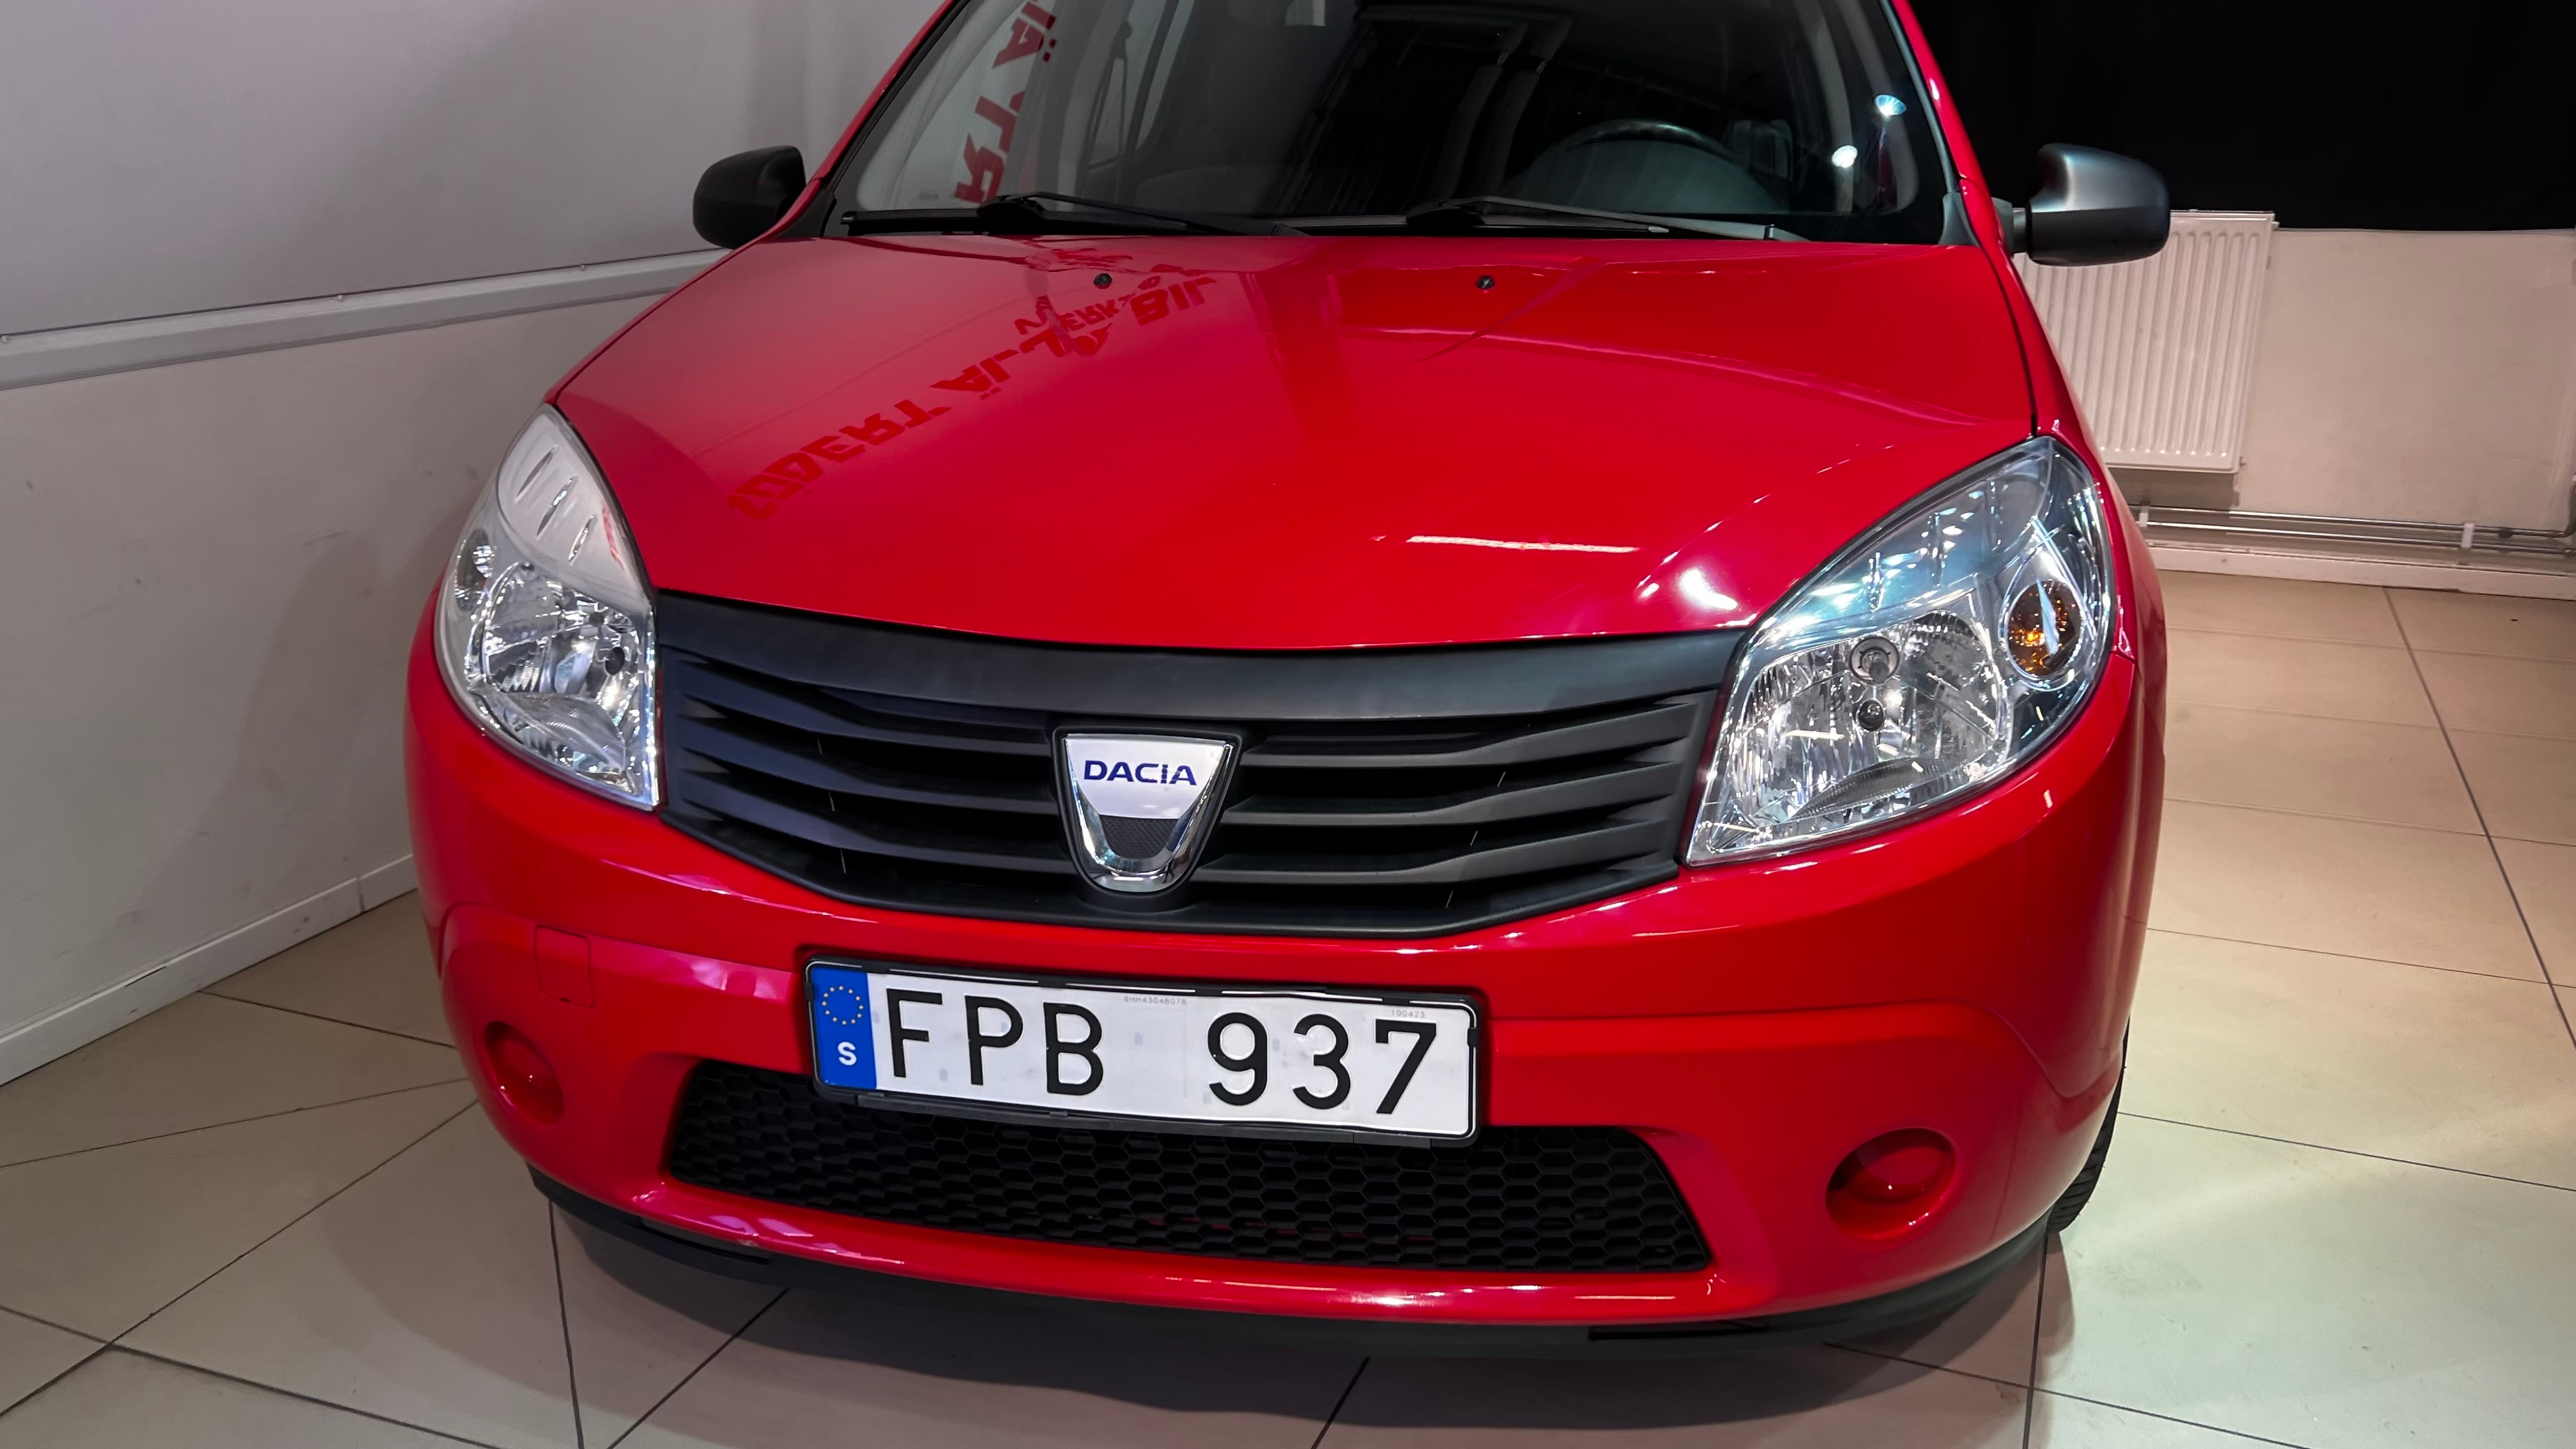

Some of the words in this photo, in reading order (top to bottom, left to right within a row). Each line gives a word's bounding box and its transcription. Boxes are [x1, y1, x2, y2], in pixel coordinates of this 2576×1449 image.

[1084, 760, 1197, 786] DACIA
[838, 1041, 857, 1066] S
[886, 988, 1103, 1095] FPB
[1207, 1012, 1438, 1114] 937
